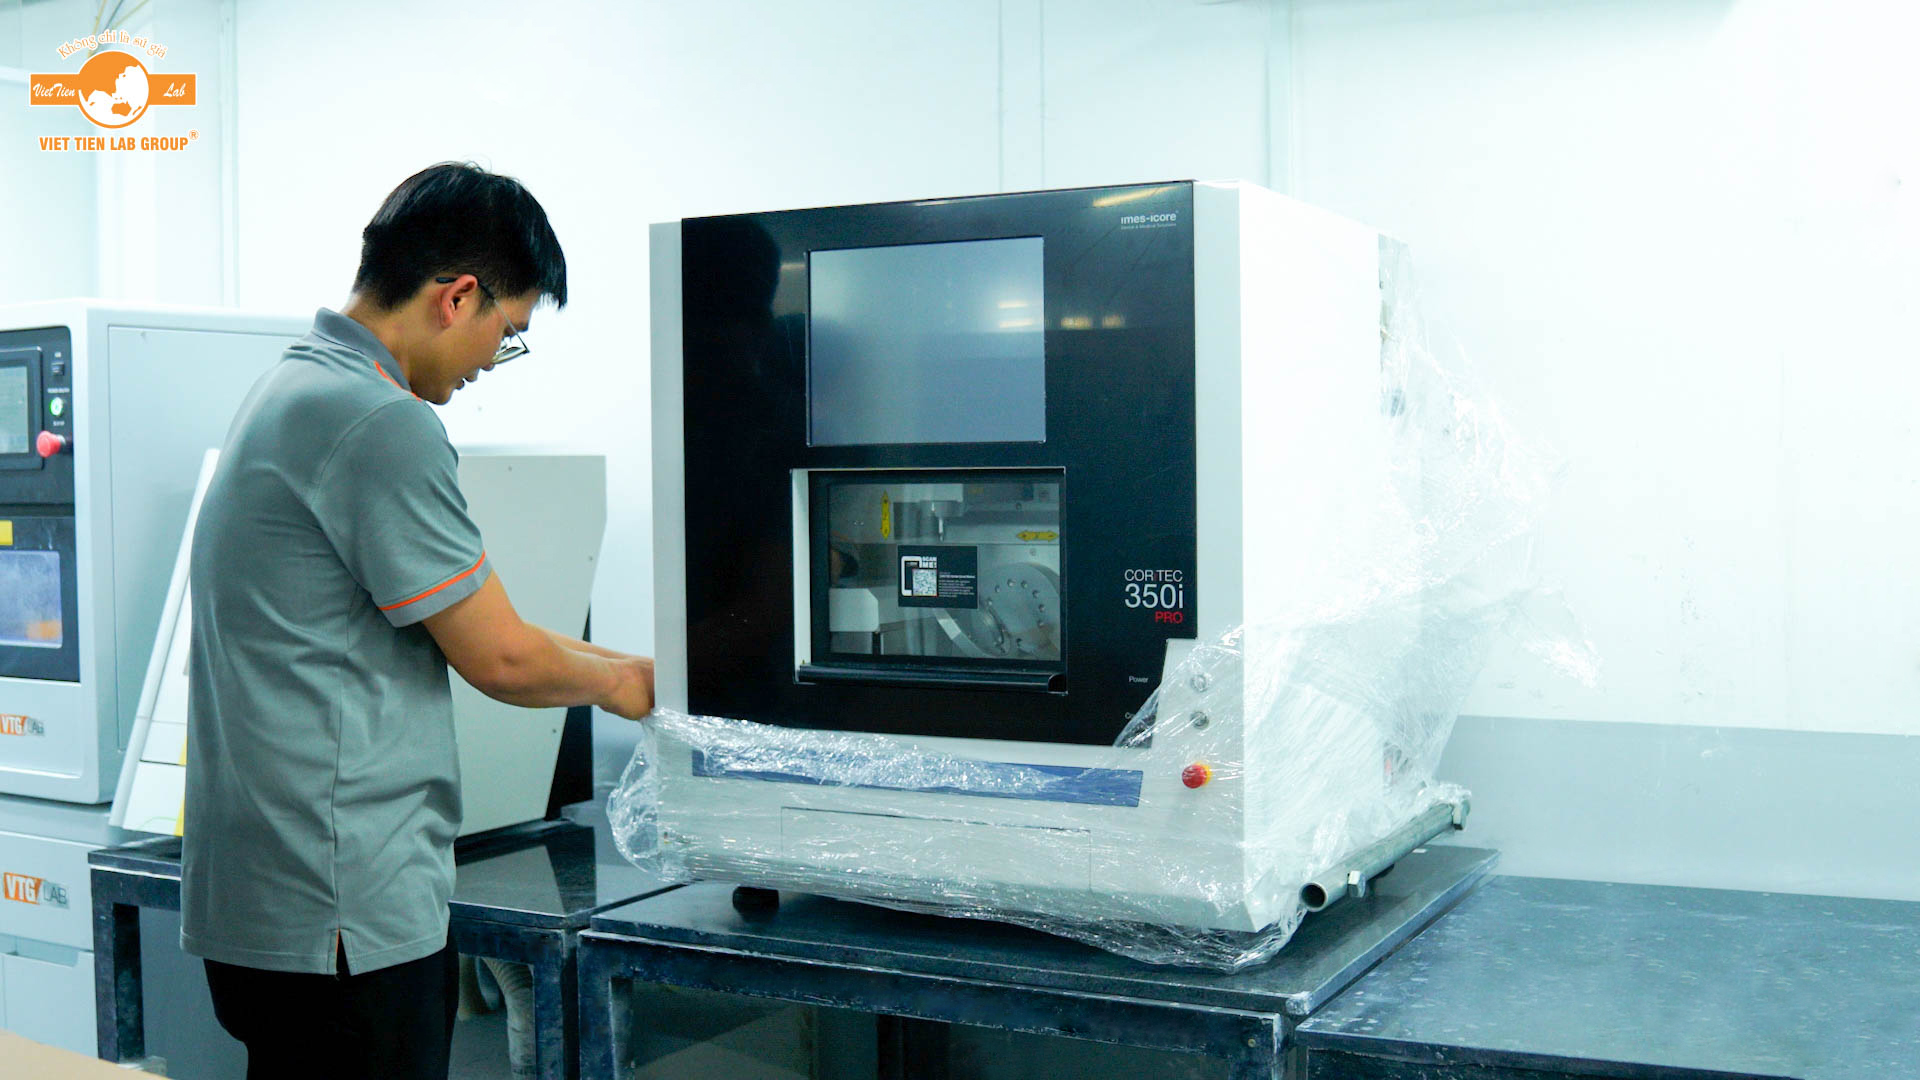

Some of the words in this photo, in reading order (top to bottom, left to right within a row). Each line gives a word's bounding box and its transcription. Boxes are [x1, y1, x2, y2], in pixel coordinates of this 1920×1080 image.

[1124, 583, 1184, 609] 350i
[1155, 611, 1184, 624] PRO
[1128, 675, 1149, 683] Power
[6, 874, 37, 902] VTG
[43, 880, 67, 905] LAB
